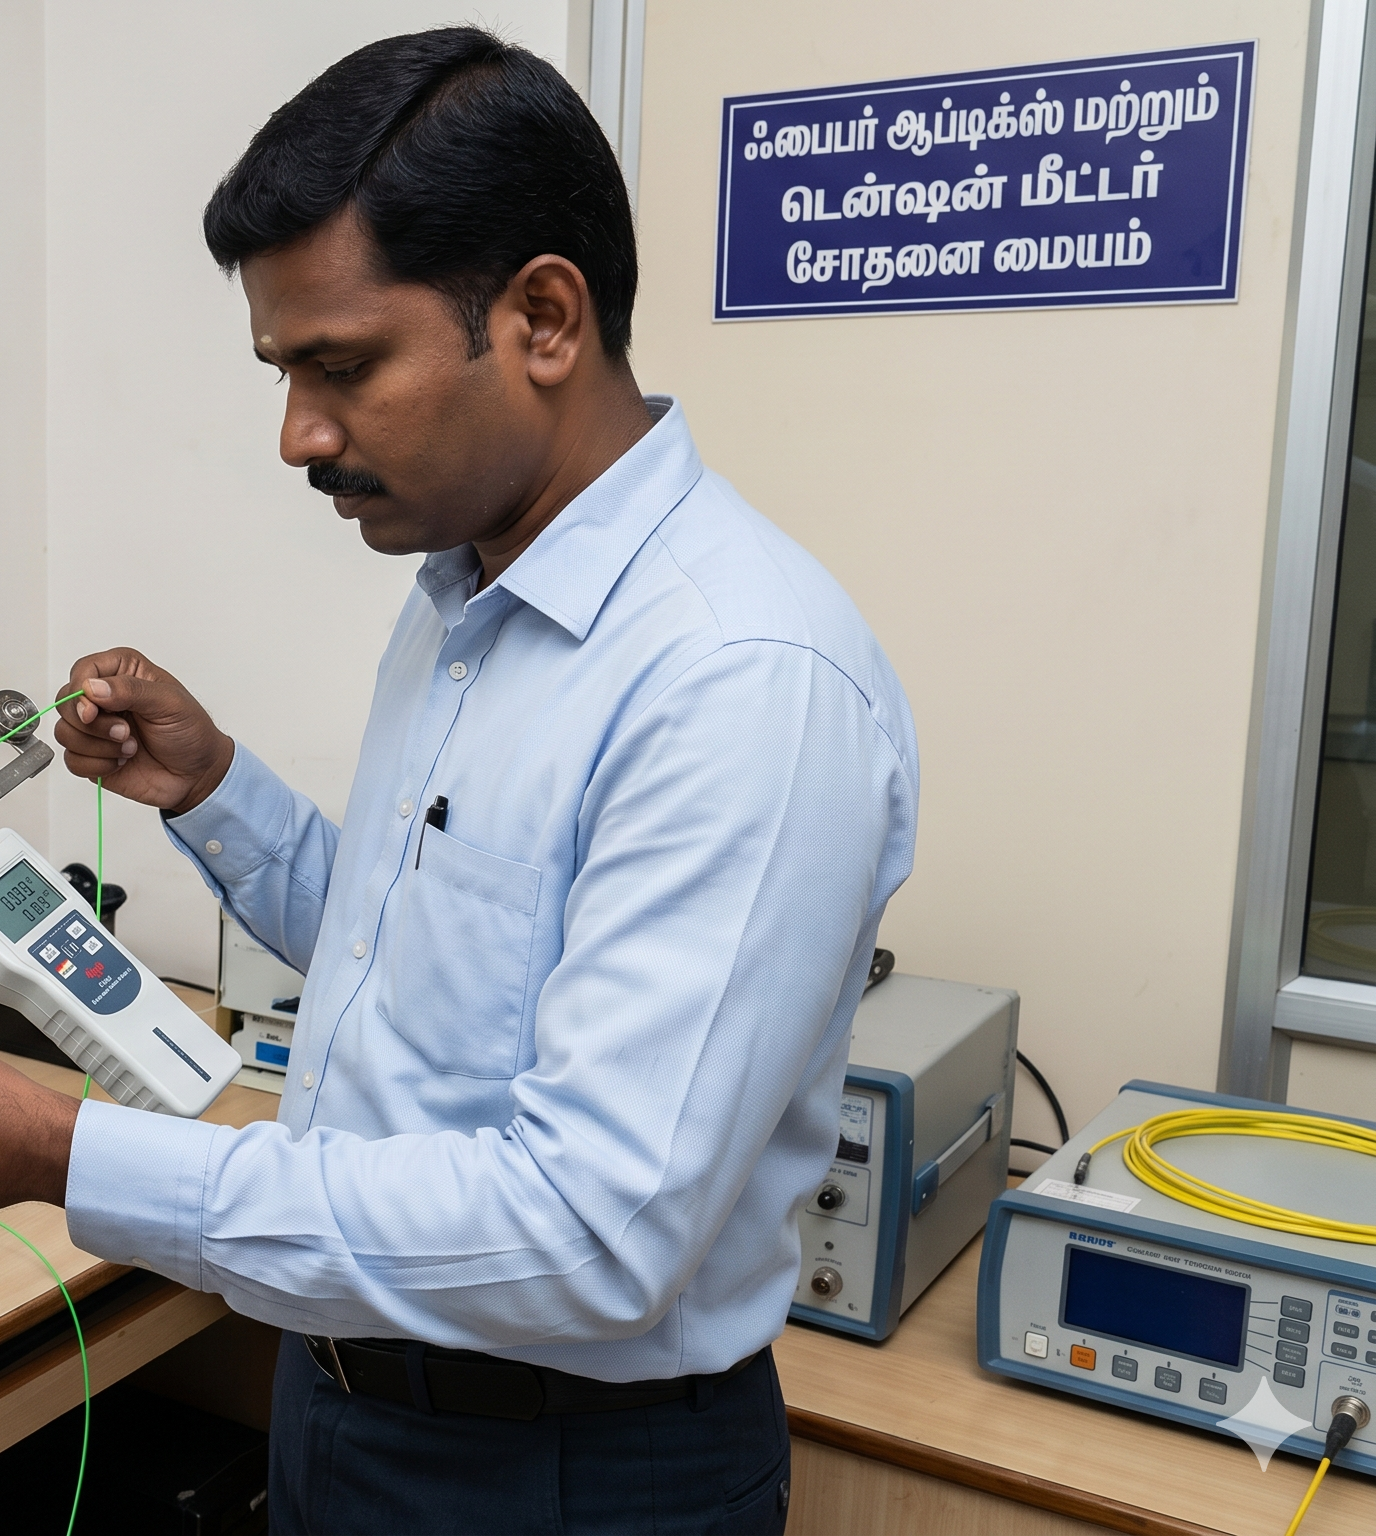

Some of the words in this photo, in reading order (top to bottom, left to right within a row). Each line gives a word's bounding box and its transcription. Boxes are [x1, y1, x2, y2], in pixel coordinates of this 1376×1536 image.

[744, 104, 880, 161] ஃபைபர்
[886, 87, 1065, 157] ஆப்டிக்ஸ்
[1073, 71, 1220, 145] மற்றும்
[781, 163, 1008, 224] டென்ஷன்
[1020, 149, 1164, 207] மீட்டர்
[786, 240, 985, 294] சோதனை
[993, 217, 1152, 273] மையம்
